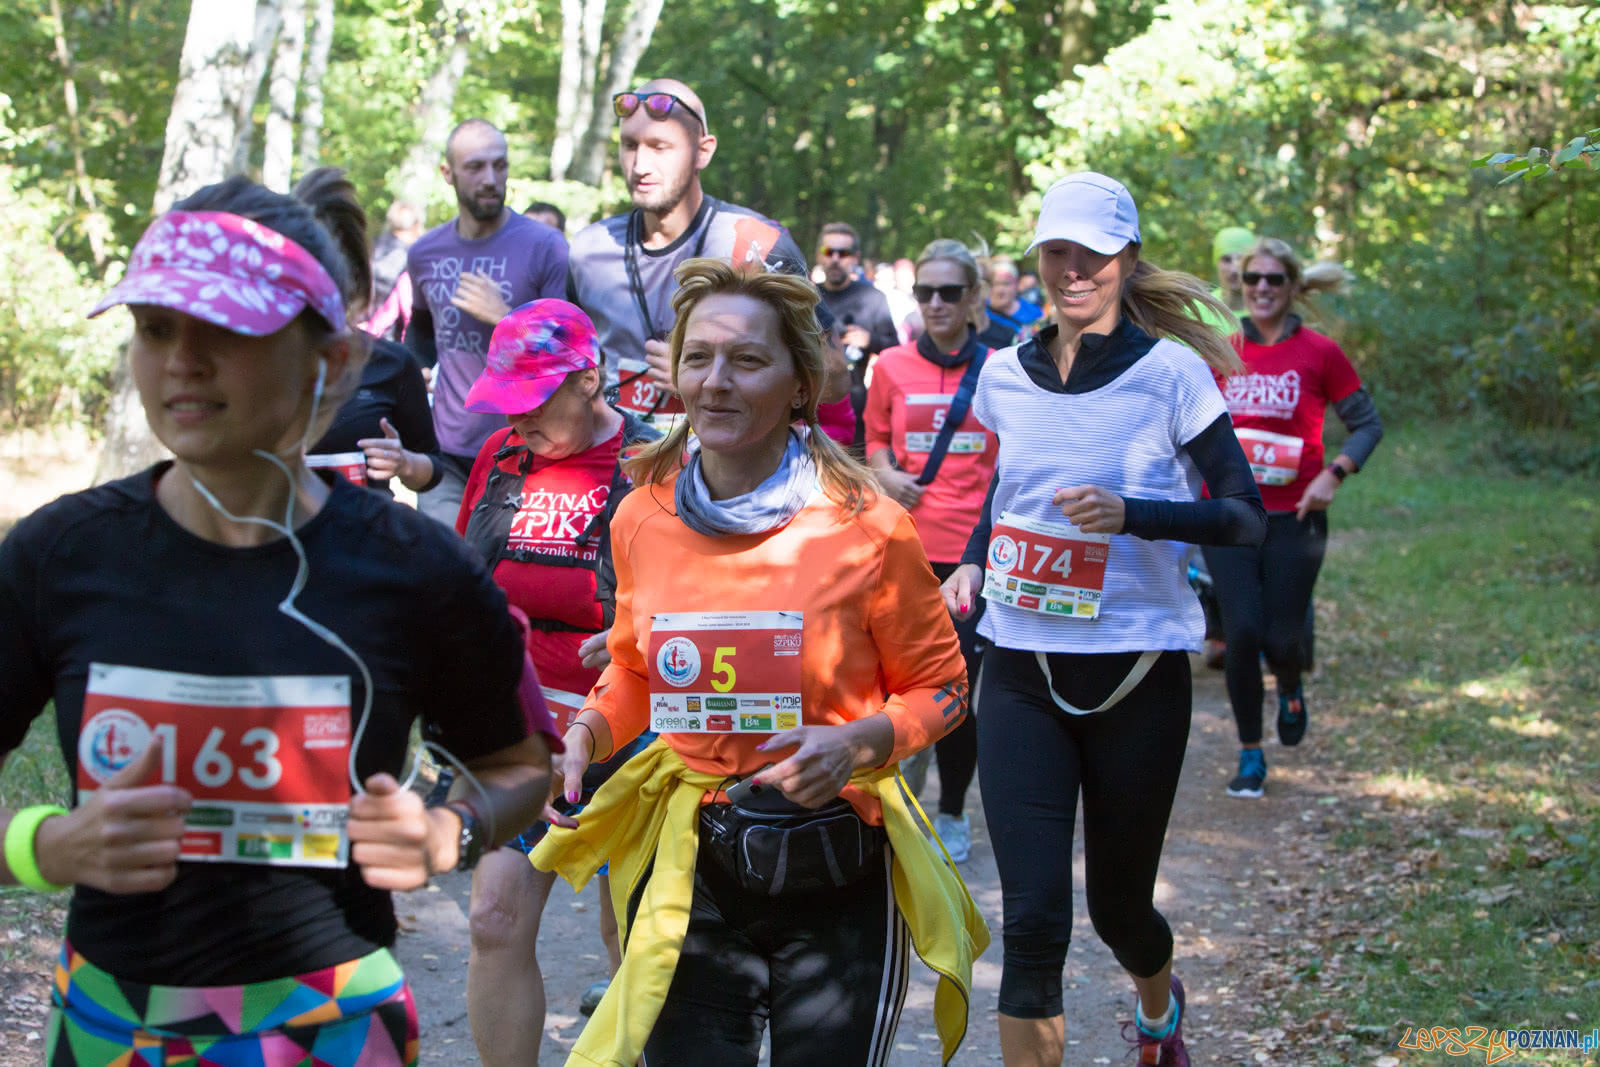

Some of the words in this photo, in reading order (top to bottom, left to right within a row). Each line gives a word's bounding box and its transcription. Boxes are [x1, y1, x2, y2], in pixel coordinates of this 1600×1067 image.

[427, 280, 513, 304] KNS
[1253, 444, 1276, 465] 96
[509, 510, 600, 540] ZPIK
[1017, 540, 1073, 578] 174
[710, 647, 737, 693] 5
[782, 696, 801, 709] mjp
[655, 717, 688, 729] green
[152, 723, 283, 790] 163
